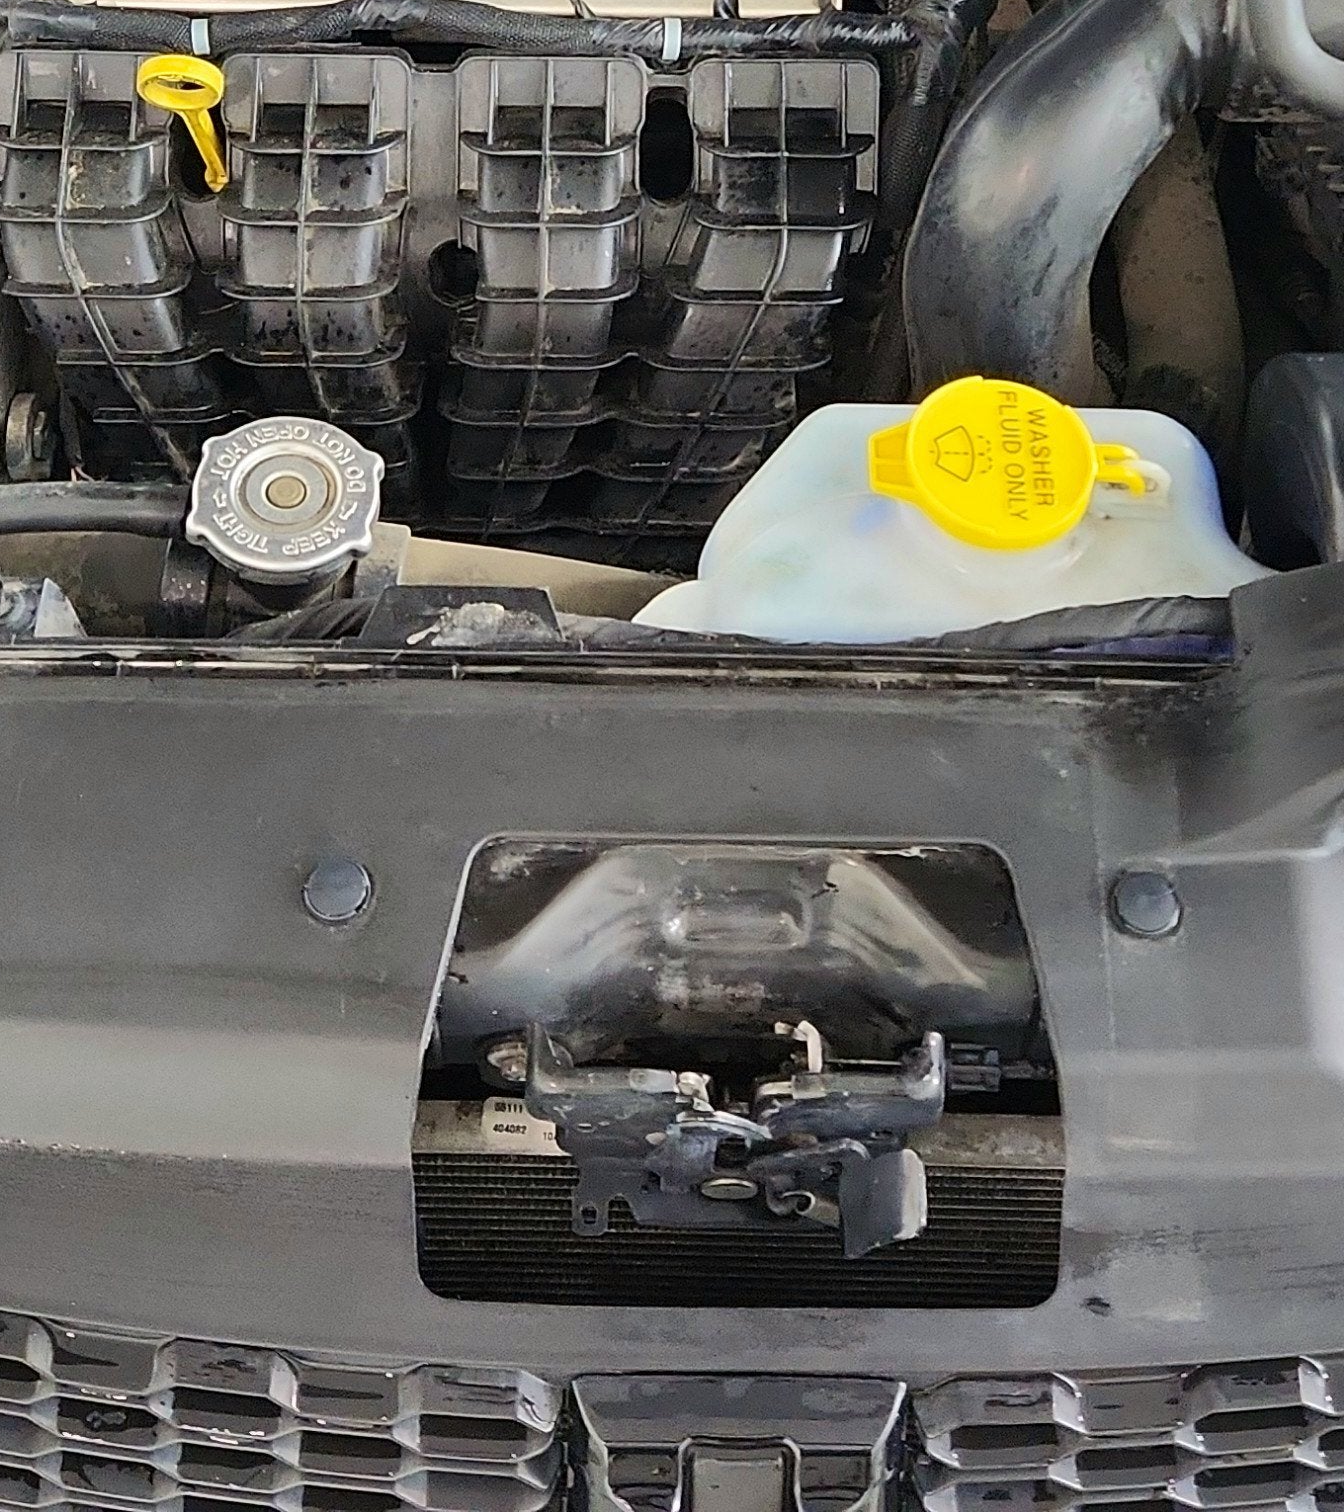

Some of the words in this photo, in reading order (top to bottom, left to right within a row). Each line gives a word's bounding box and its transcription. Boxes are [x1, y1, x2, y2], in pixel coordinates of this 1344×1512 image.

[245, 425, 310, 448] OPEN
[997, 390, 1023, 455] FLUID
[210, 441, 248, 481] HOT
[312, 432, 356, 465] NOT
[1026, 407, 1055, 507] WASHER
[344, 466, 367, 493] DO
[1004, 462, 1029, 522] ONLY
[212, 512, 269, 554] TIGHT
[282, 520, 346, 556] KEEP
